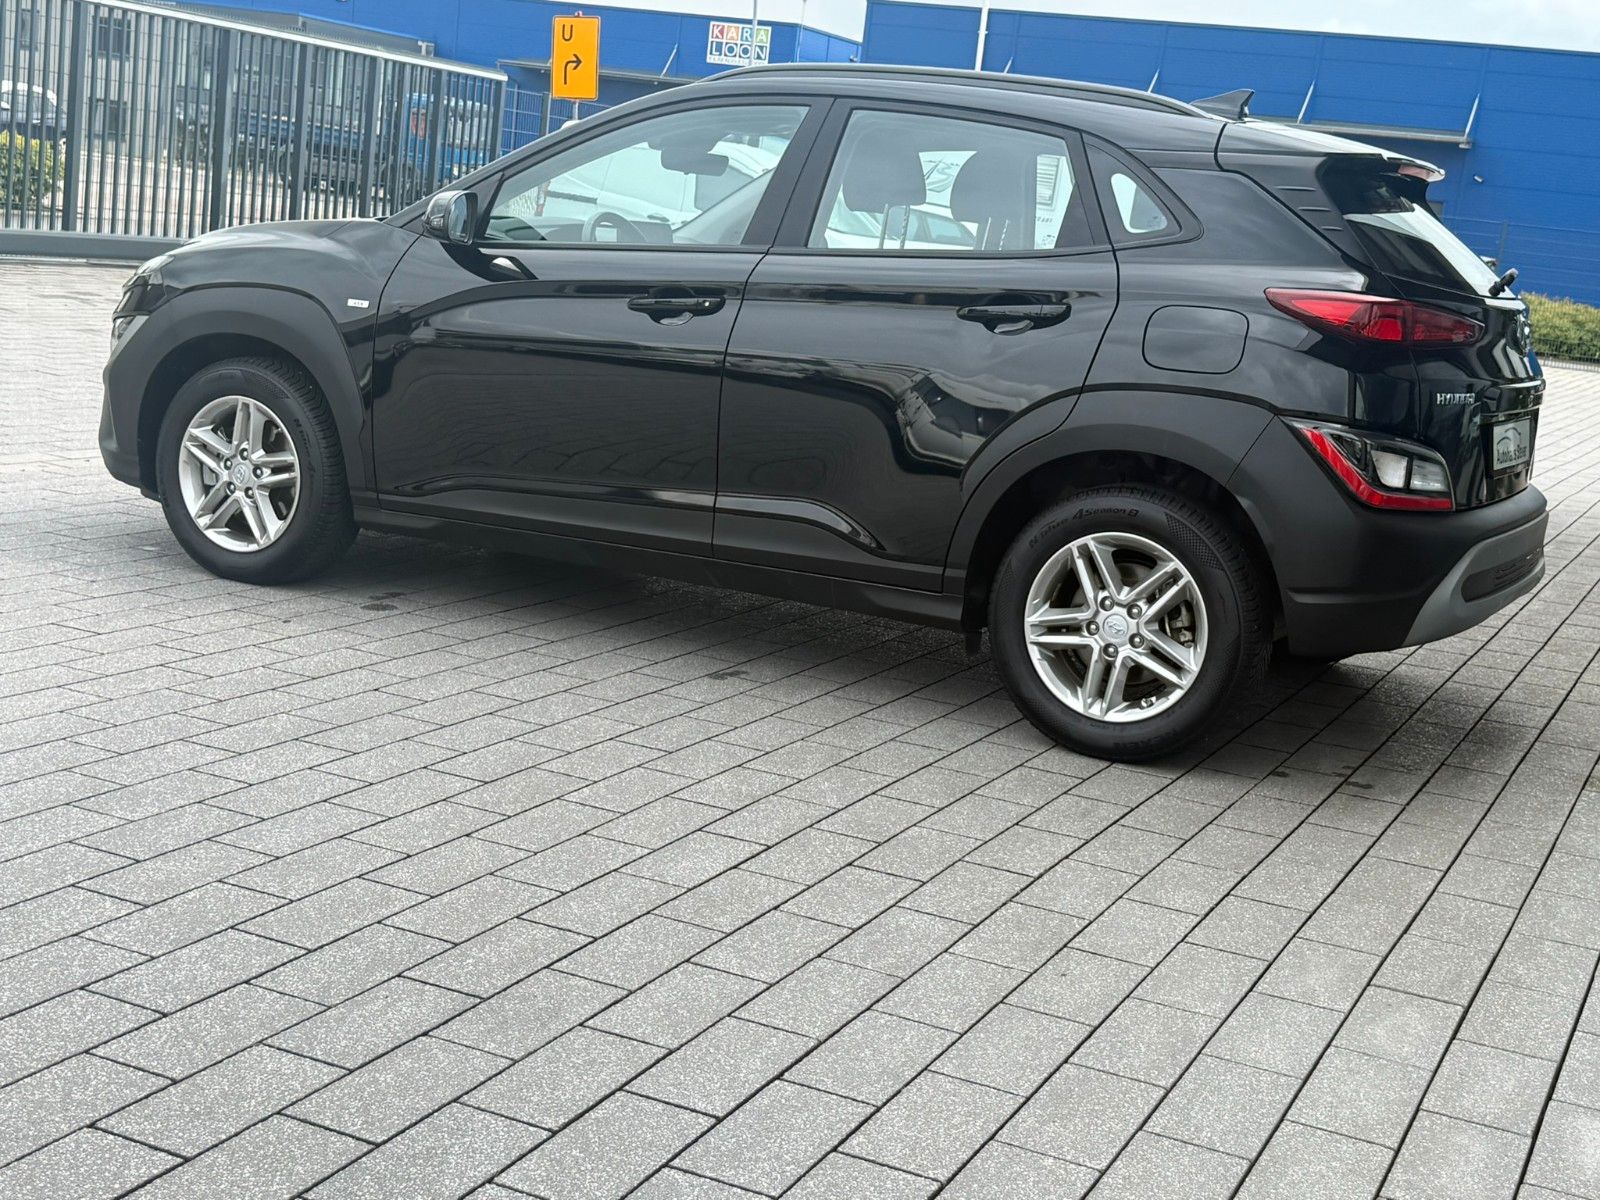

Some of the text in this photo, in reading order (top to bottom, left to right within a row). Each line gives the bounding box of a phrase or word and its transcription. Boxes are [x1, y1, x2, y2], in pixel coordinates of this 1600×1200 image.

[562, 24, 573, 42] U
[713, 25, 767, 43] KARA
[712, 42, 766, 60] LOON
